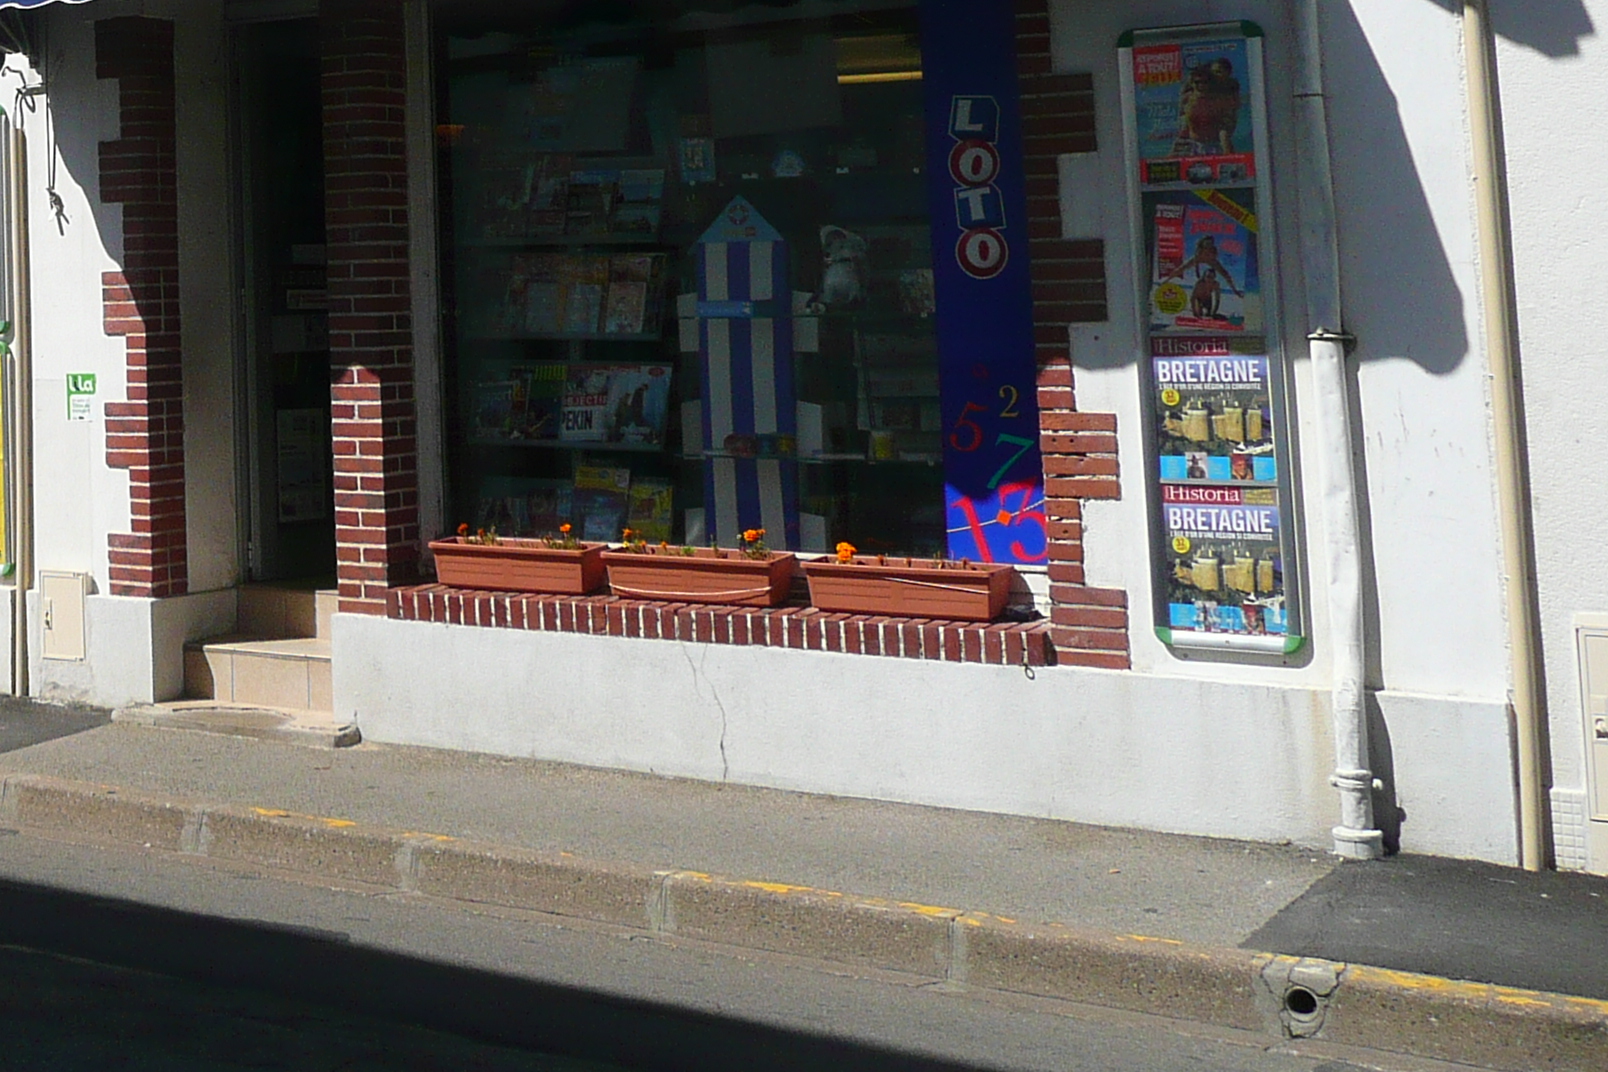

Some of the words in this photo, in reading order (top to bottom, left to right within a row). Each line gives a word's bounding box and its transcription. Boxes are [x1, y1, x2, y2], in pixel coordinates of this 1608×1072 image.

[948, 96, 1008, 278] LOTO
[1158, 338, 1229, 353] Historia
[1157, 359, 1261, 382] BRETAGNE
[999, 385, 1020, 417] 2
[950, 401, 989, 451] 5
[987, 433, 1035, 489] 7
[1169, 485, 1240, 501] Historia
[1169, 507, 1273, 533] BRETAGNE
